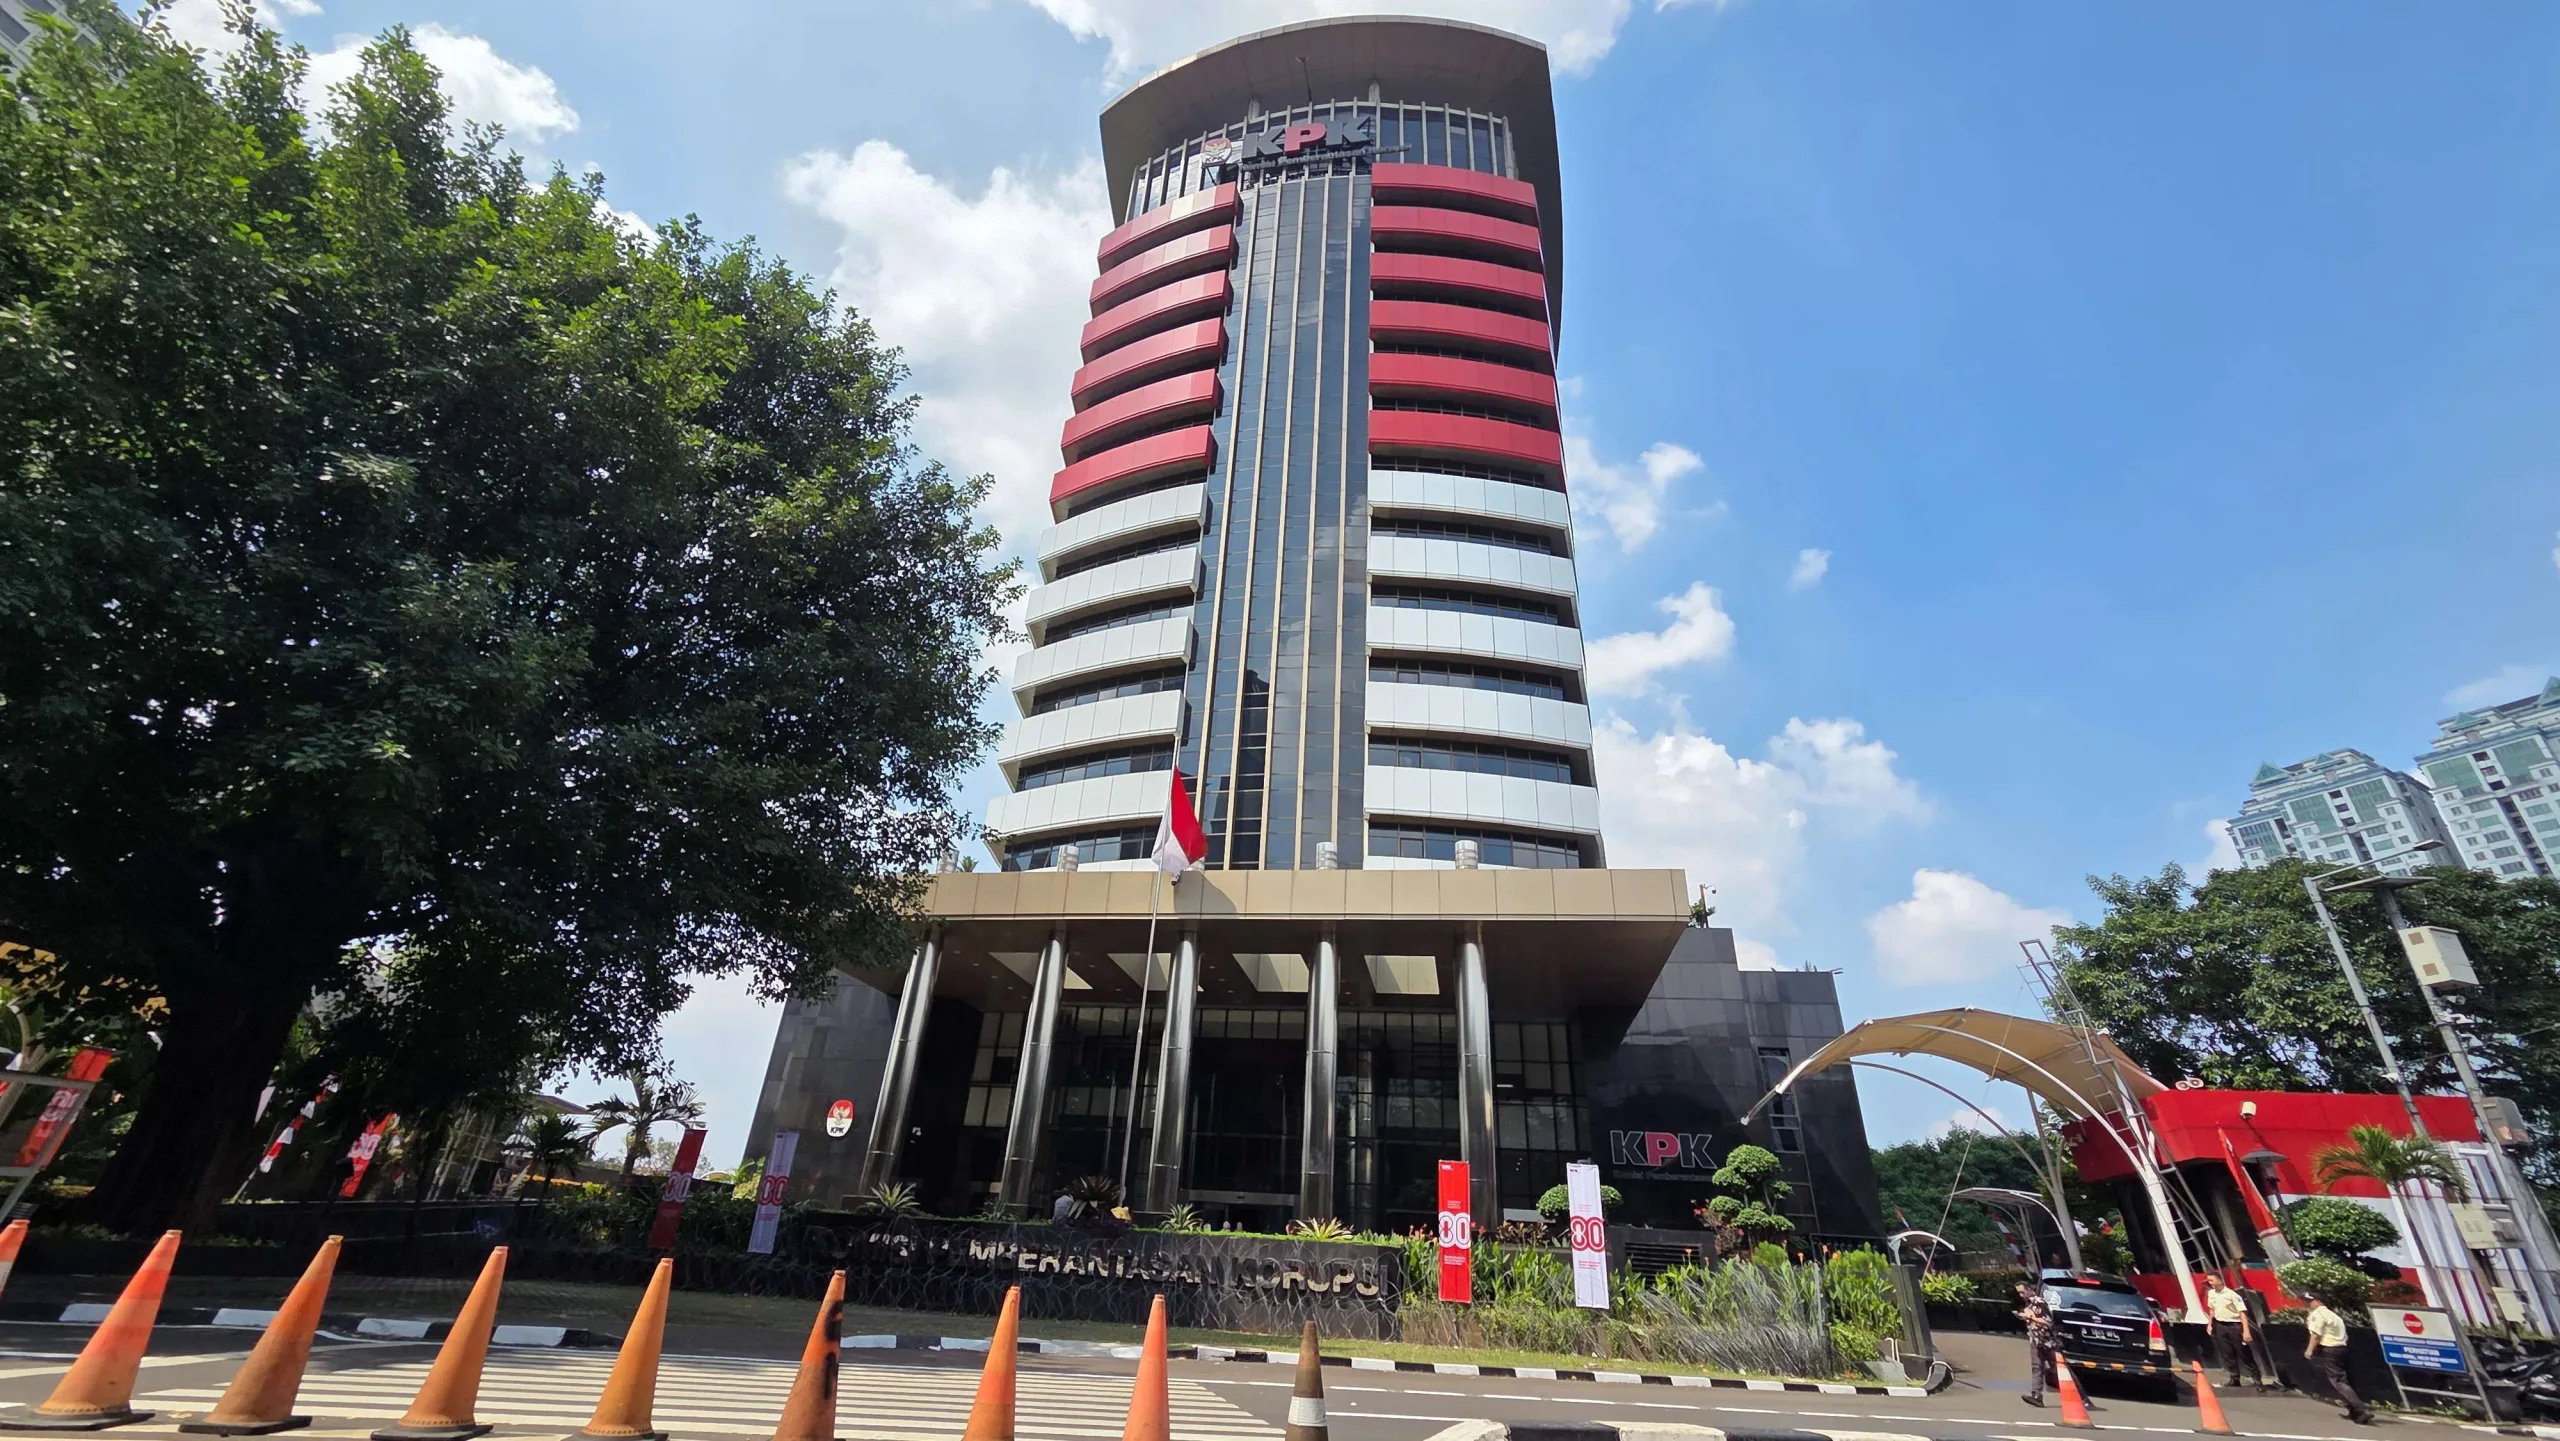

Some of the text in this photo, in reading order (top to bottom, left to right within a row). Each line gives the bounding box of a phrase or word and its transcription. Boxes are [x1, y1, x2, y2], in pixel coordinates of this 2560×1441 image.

[1242, 116, 1371, 160] KPK
[830, 1126, 845, 1134] KPK
[1609, 1130, 1718, 1169] KPK
[662, 1171, 692, 1203] 80
[760, 1174, 789, 1207] 80
[1439, 1211, 1471, 1249] 80
[1570, 1215, 1605, 1253] 80
